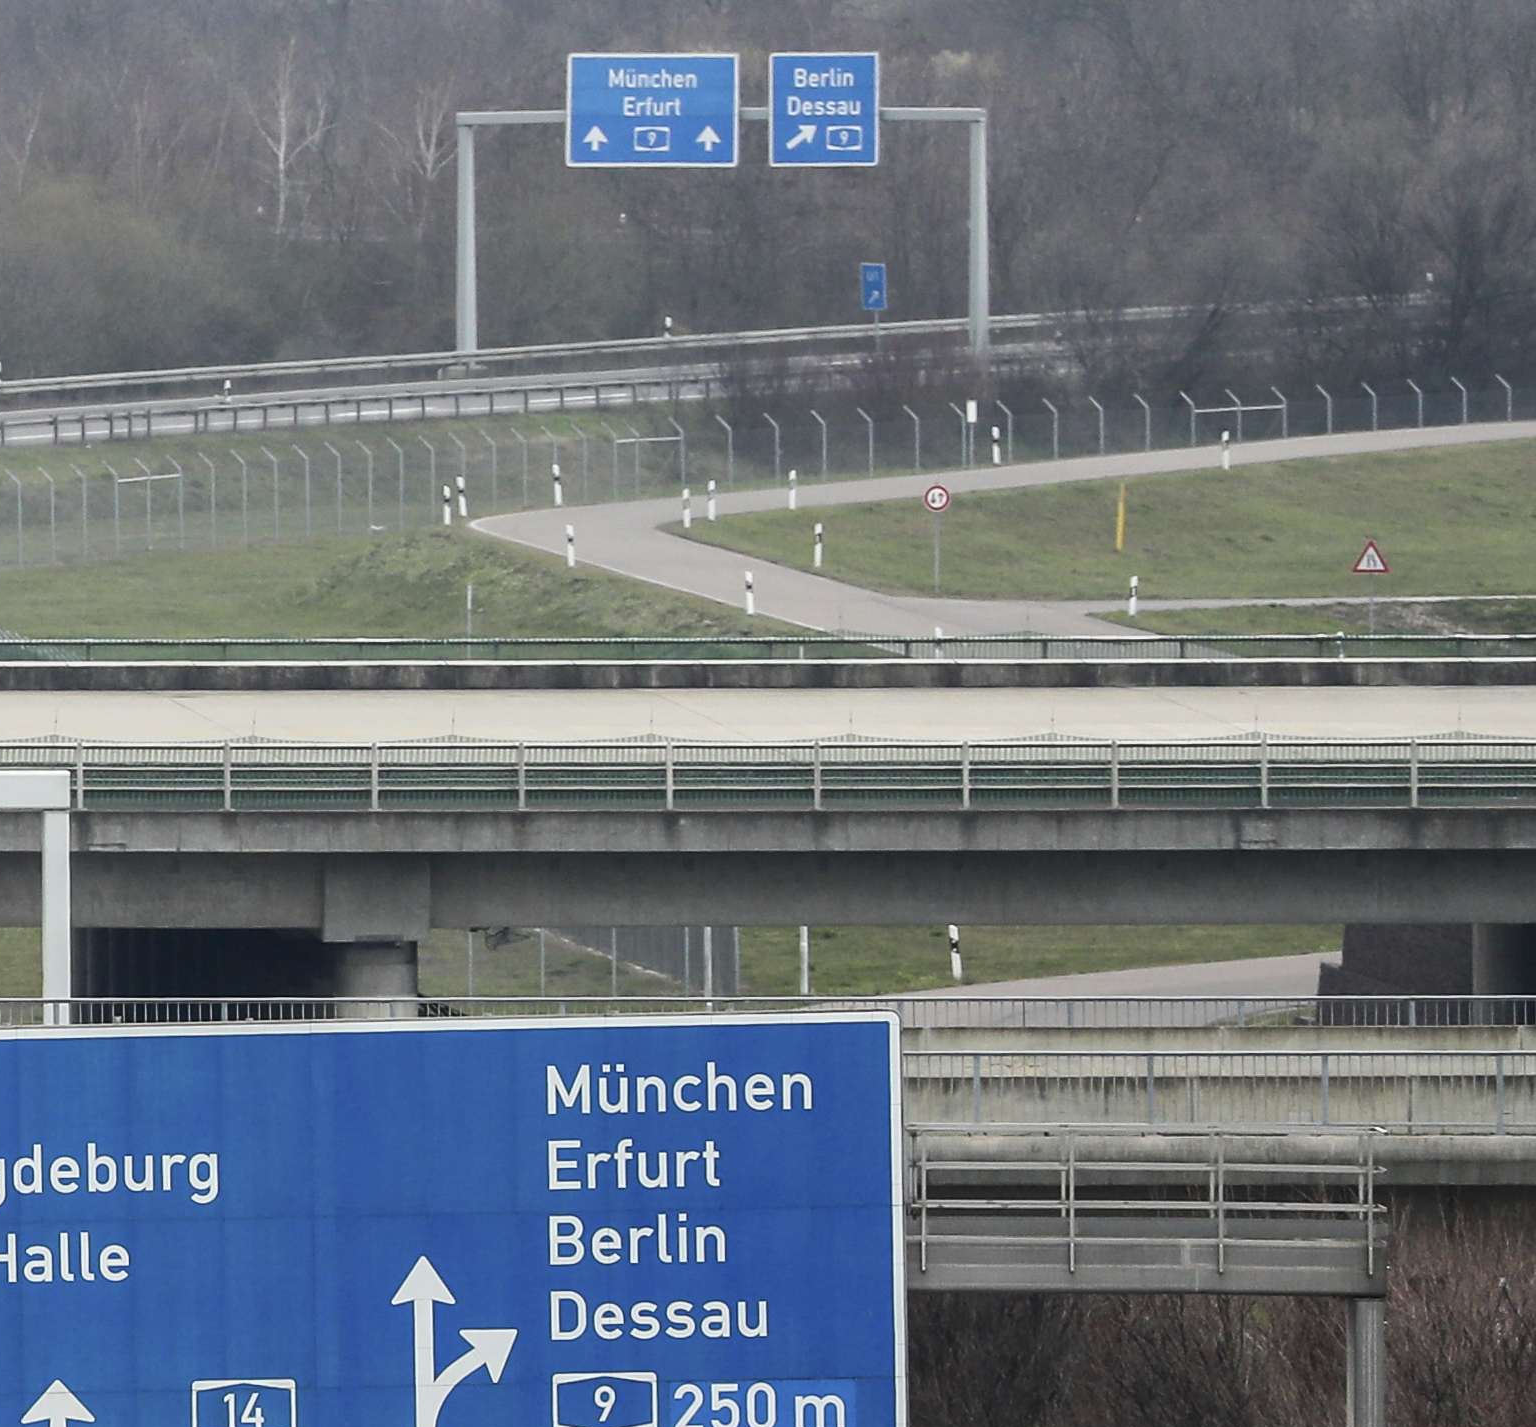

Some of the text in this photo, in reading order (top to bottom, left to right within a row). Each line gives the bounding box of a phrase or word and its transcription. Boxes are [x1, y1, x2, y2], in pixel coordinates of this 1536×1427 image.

[608, 68, 698, 89] München
[793, 67, 855, 88] Berlin
[622, 95, 682, 117] Erfurt
[787, 95, 861, 116] Dessau
[647, 131, 657, 146] 9
[839, 130, 849, 145] 9
[546, 1061, 812, 1115] München
[547, 1138, 721, 1190] Erfurt
[549, 1213, 726, 1266] Berlin
[550, 1290, 768, 1341] Dessau
[594, 1385, 616, 1422] 9
